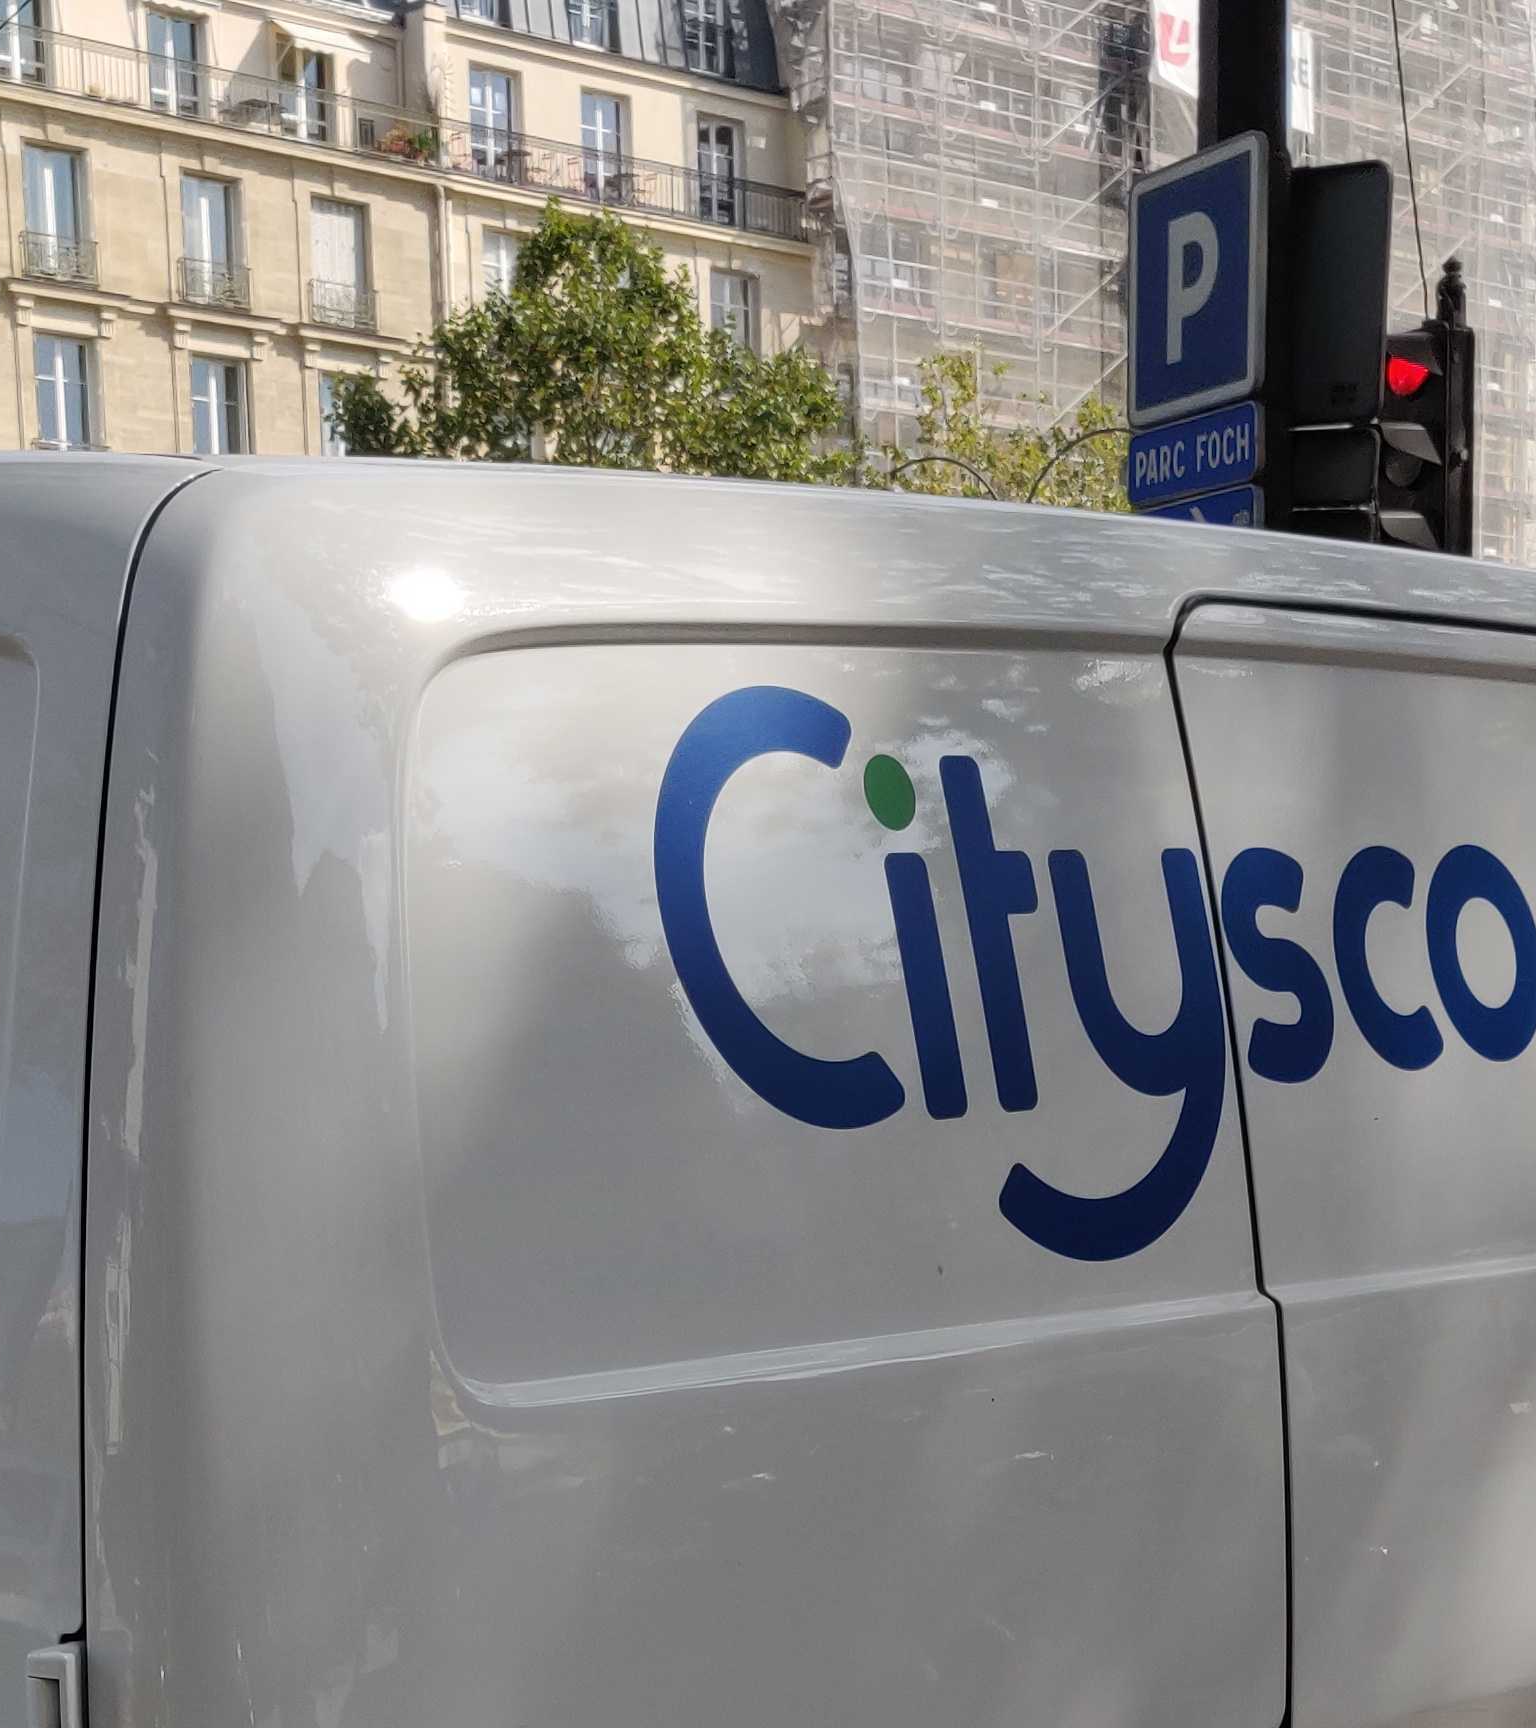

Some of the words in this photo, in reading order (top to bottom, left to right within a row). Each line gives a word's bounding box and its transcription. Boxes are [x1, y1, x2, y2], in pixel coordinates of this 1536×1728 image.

[1166, 211, 1219, 365] P
[1135, 440, 1185, 489] PARC
[1196, 422, 1250, 473] FOCH
